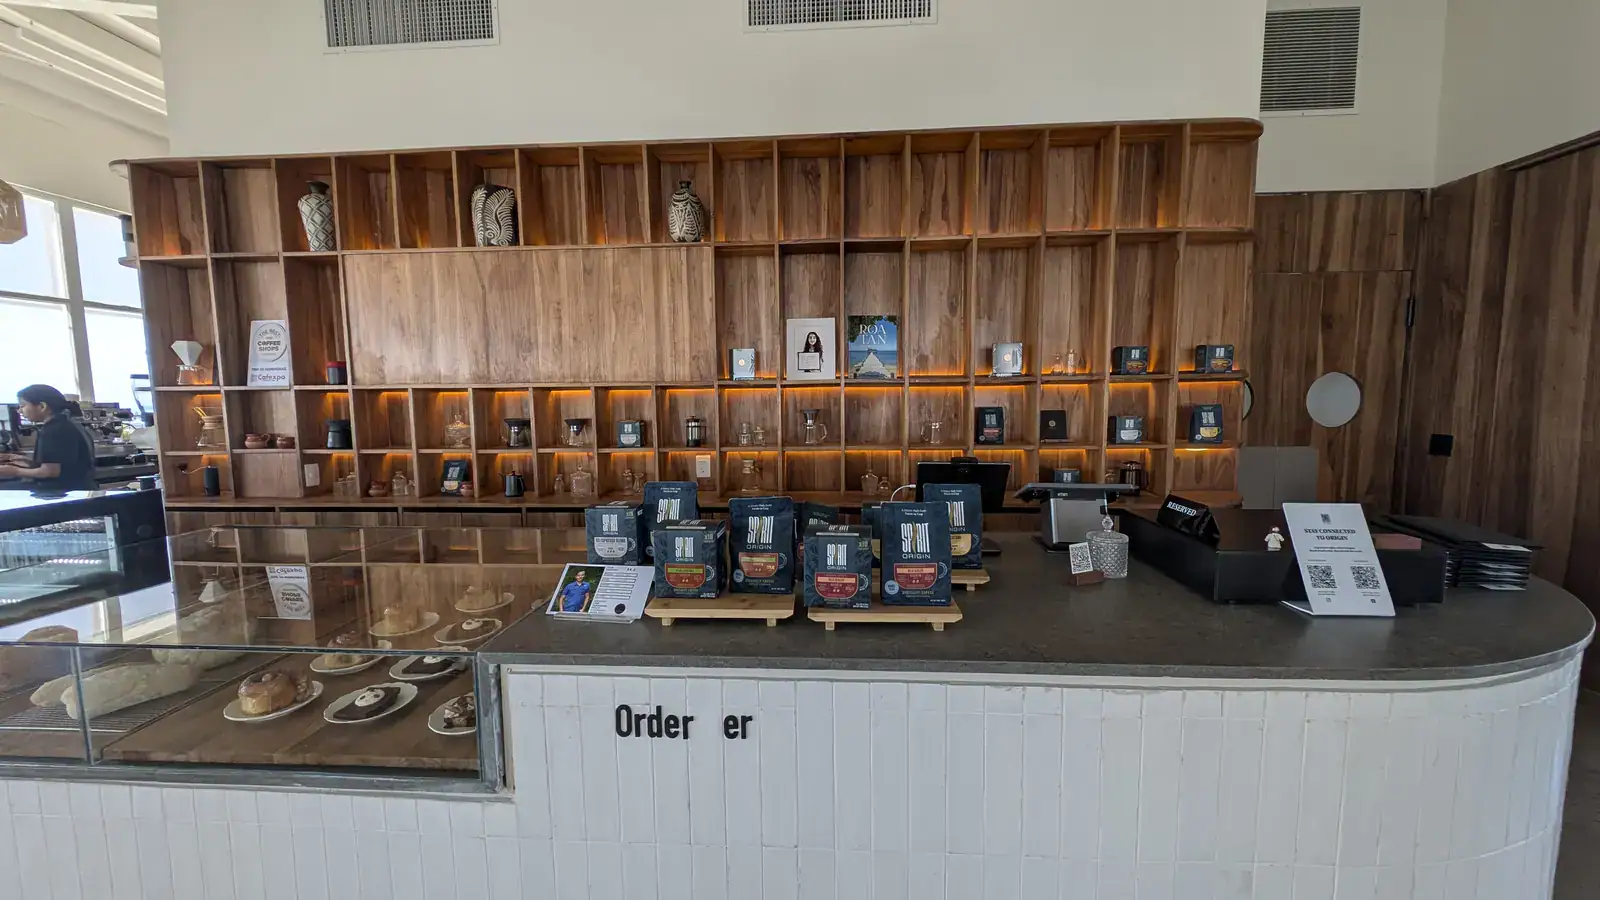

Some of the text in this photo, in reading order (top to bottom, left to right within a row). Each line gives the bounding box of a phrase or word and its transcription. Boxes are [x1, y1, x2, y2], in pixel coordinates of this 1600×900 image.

[859, 324, 887, 335] ROA
[861, 334, 887, 345] TAN
[1166, 501, 1197, 517] RESERVED
[747, 515, 775, 544] SPIRIT
[901, 521, 931, 553] SPIRIT
[675, 536, 694, 558] SPIRIT
[827, 542, 847, 566] SPIRIT
[615, 704, 753, 740] Order er
